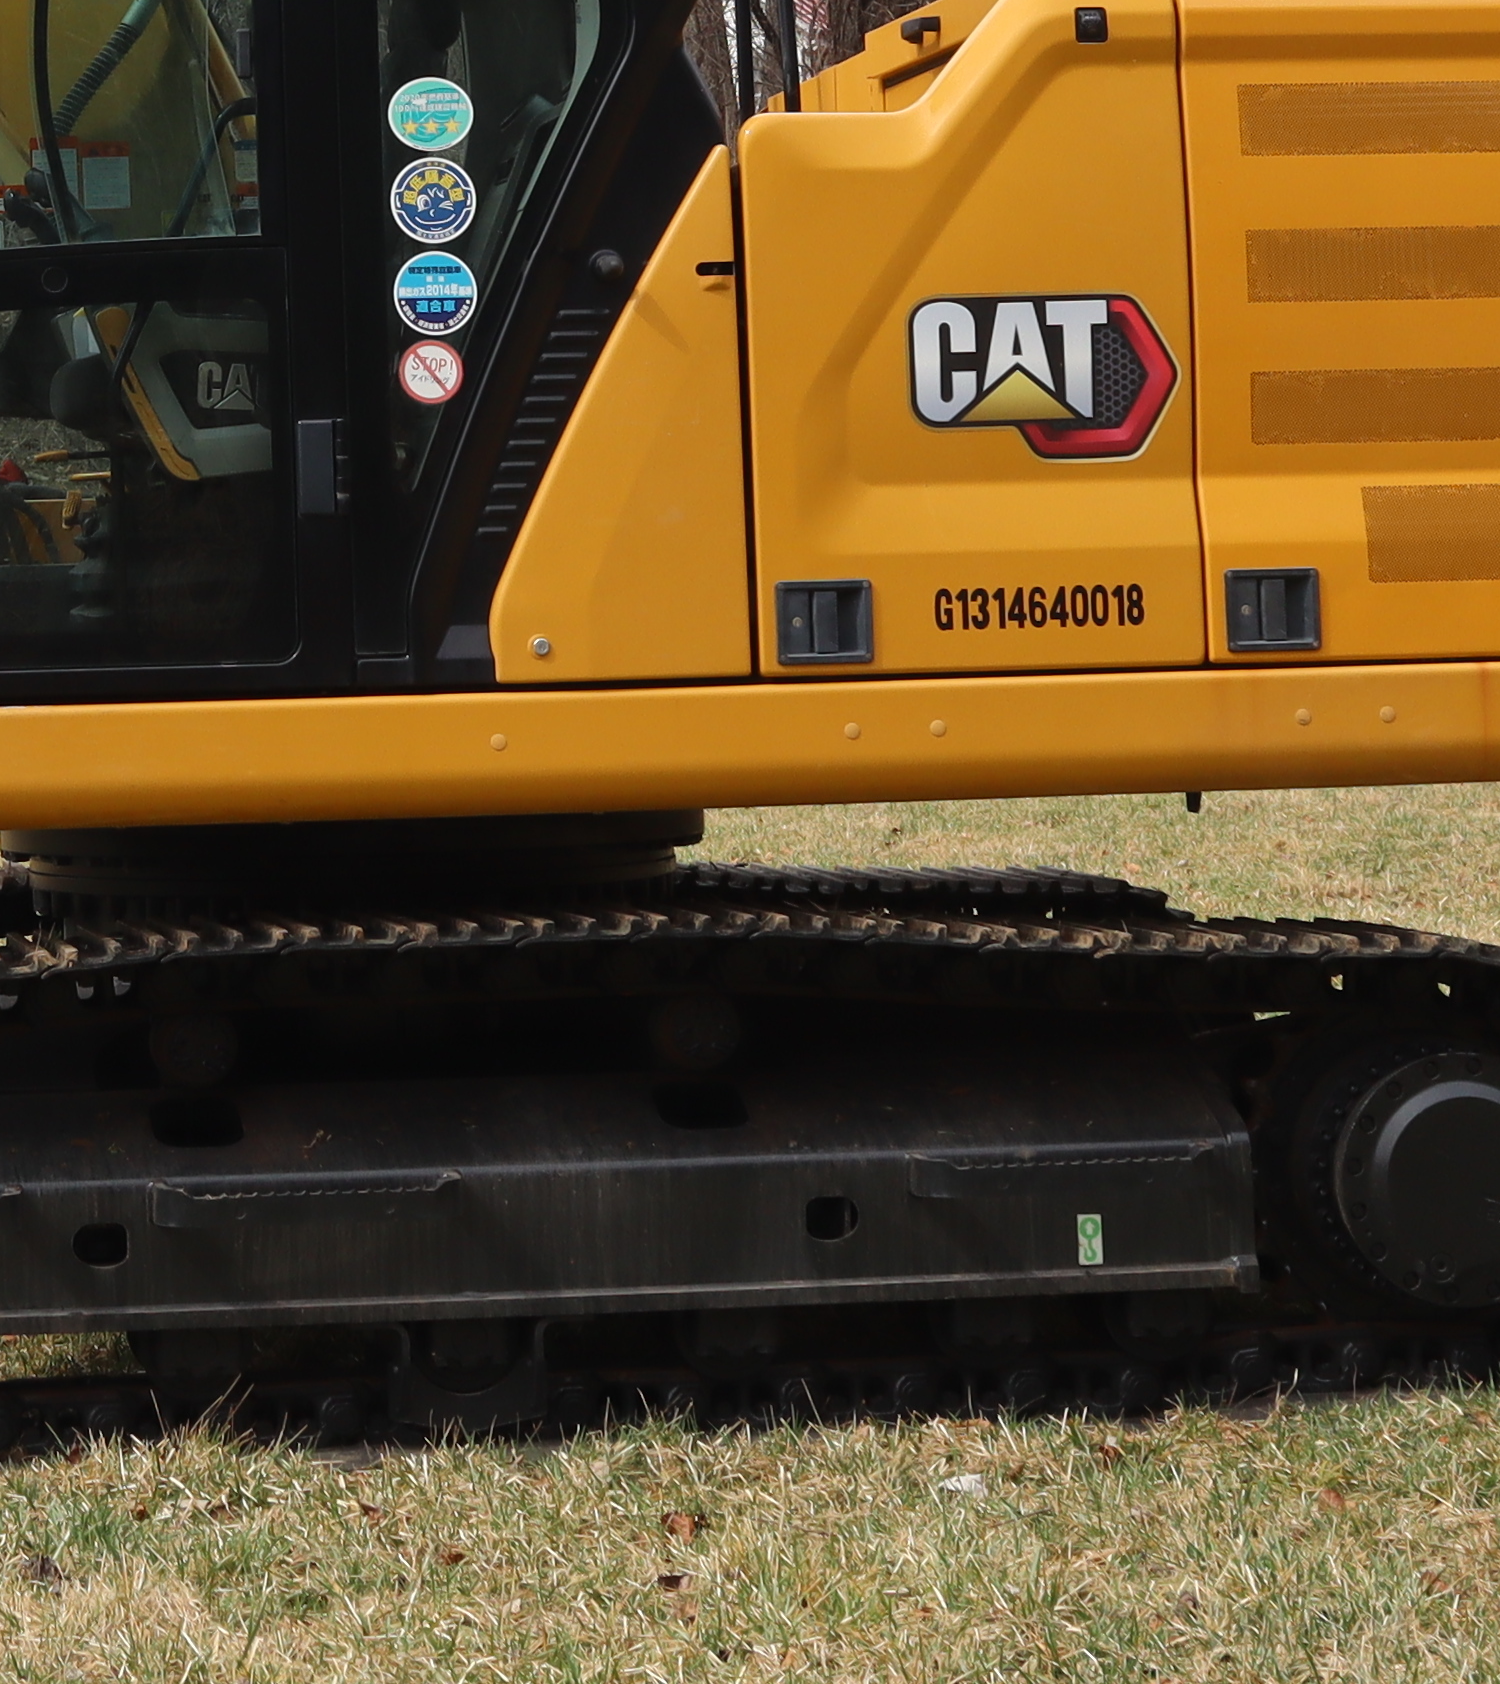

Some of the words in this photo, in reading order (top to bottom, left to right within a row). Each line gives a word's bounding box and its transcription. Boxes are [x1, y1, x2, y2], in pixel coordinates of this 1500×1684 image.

[913, 299, 1107, 422] CAT
[197, 361, 259, 410] CA
[935, 583, 1145, 630] G1314640018
